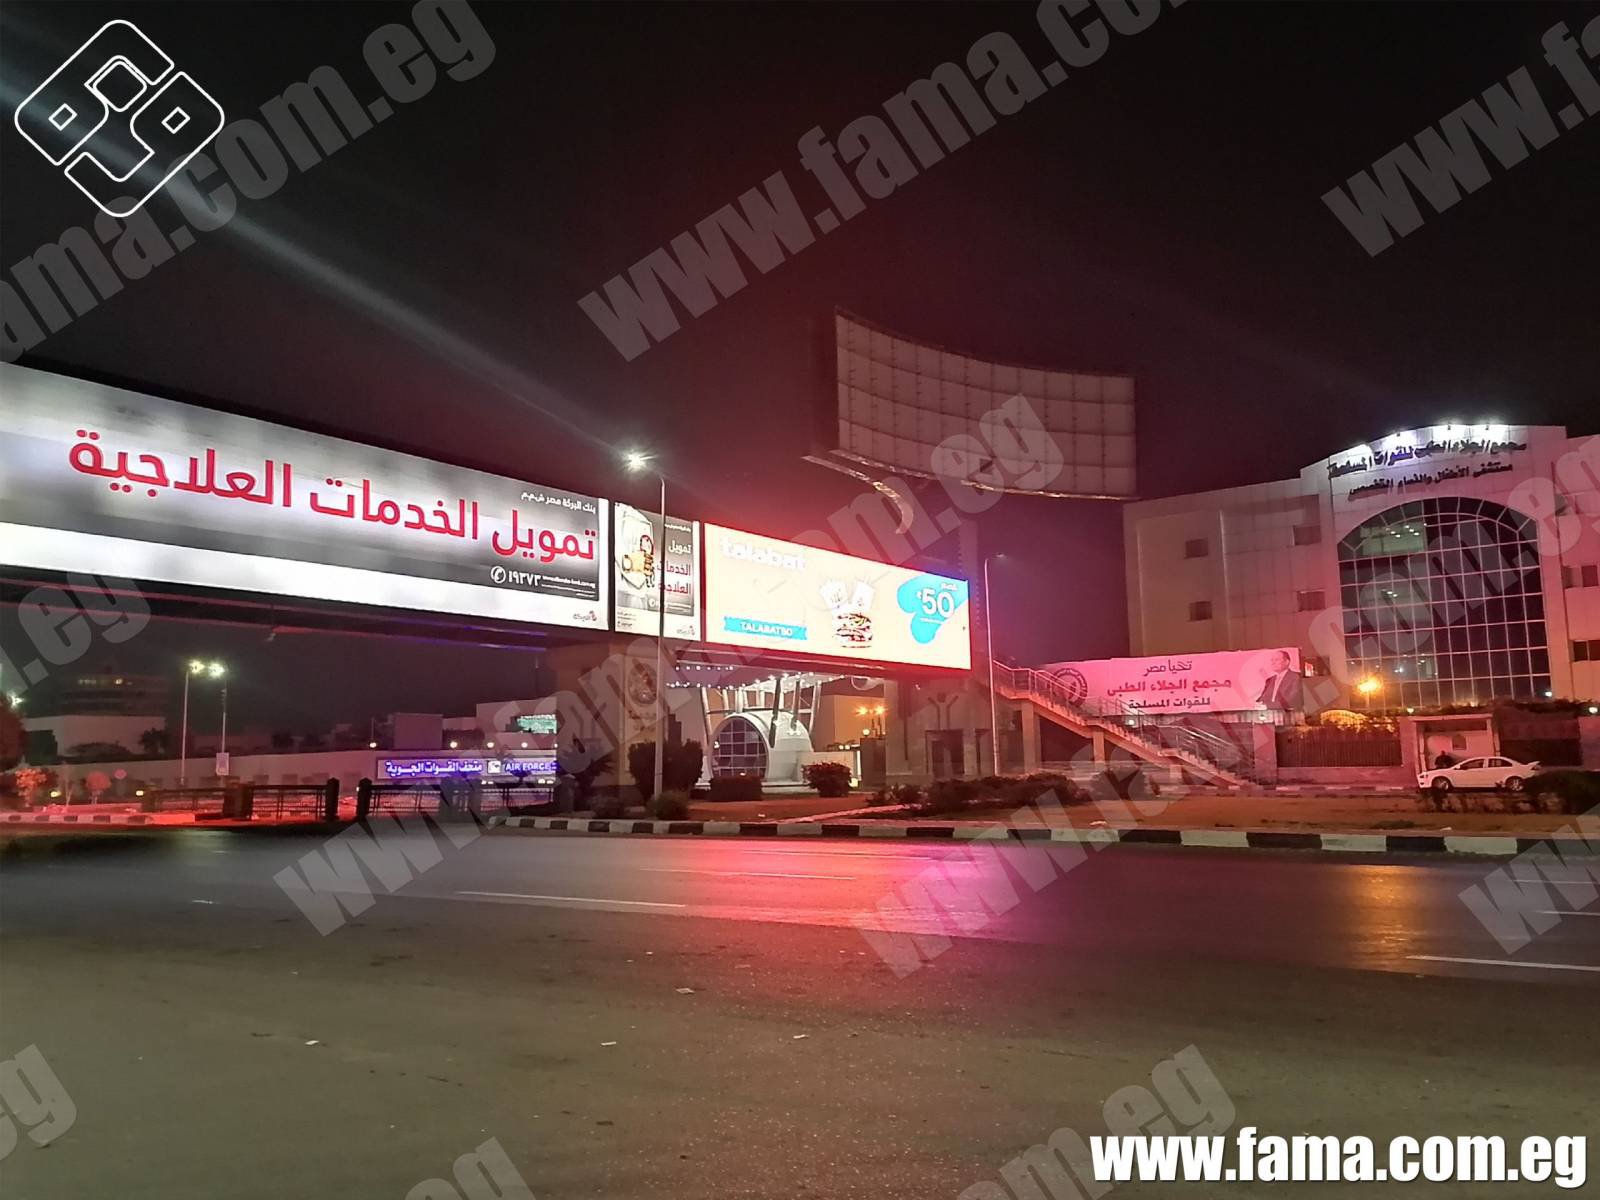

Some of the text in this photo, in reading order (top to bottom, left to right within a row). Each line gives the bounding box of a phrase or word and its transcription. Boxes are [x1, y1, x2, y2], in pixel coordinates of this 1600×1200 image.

[68, 428, 597, 564] تمويل الخدمات العلاجية
[1143, 659, 1193, 677] تحيا مصر
[1150, 678, 1188, 694] الجلاء
[1192, 679, 1232, 692] مجمع
[1128, 697, 1210, 710] للقوات المسلحة
[459, 760, 483, 772] متحف
[505, 762, 521, 771] AIR
